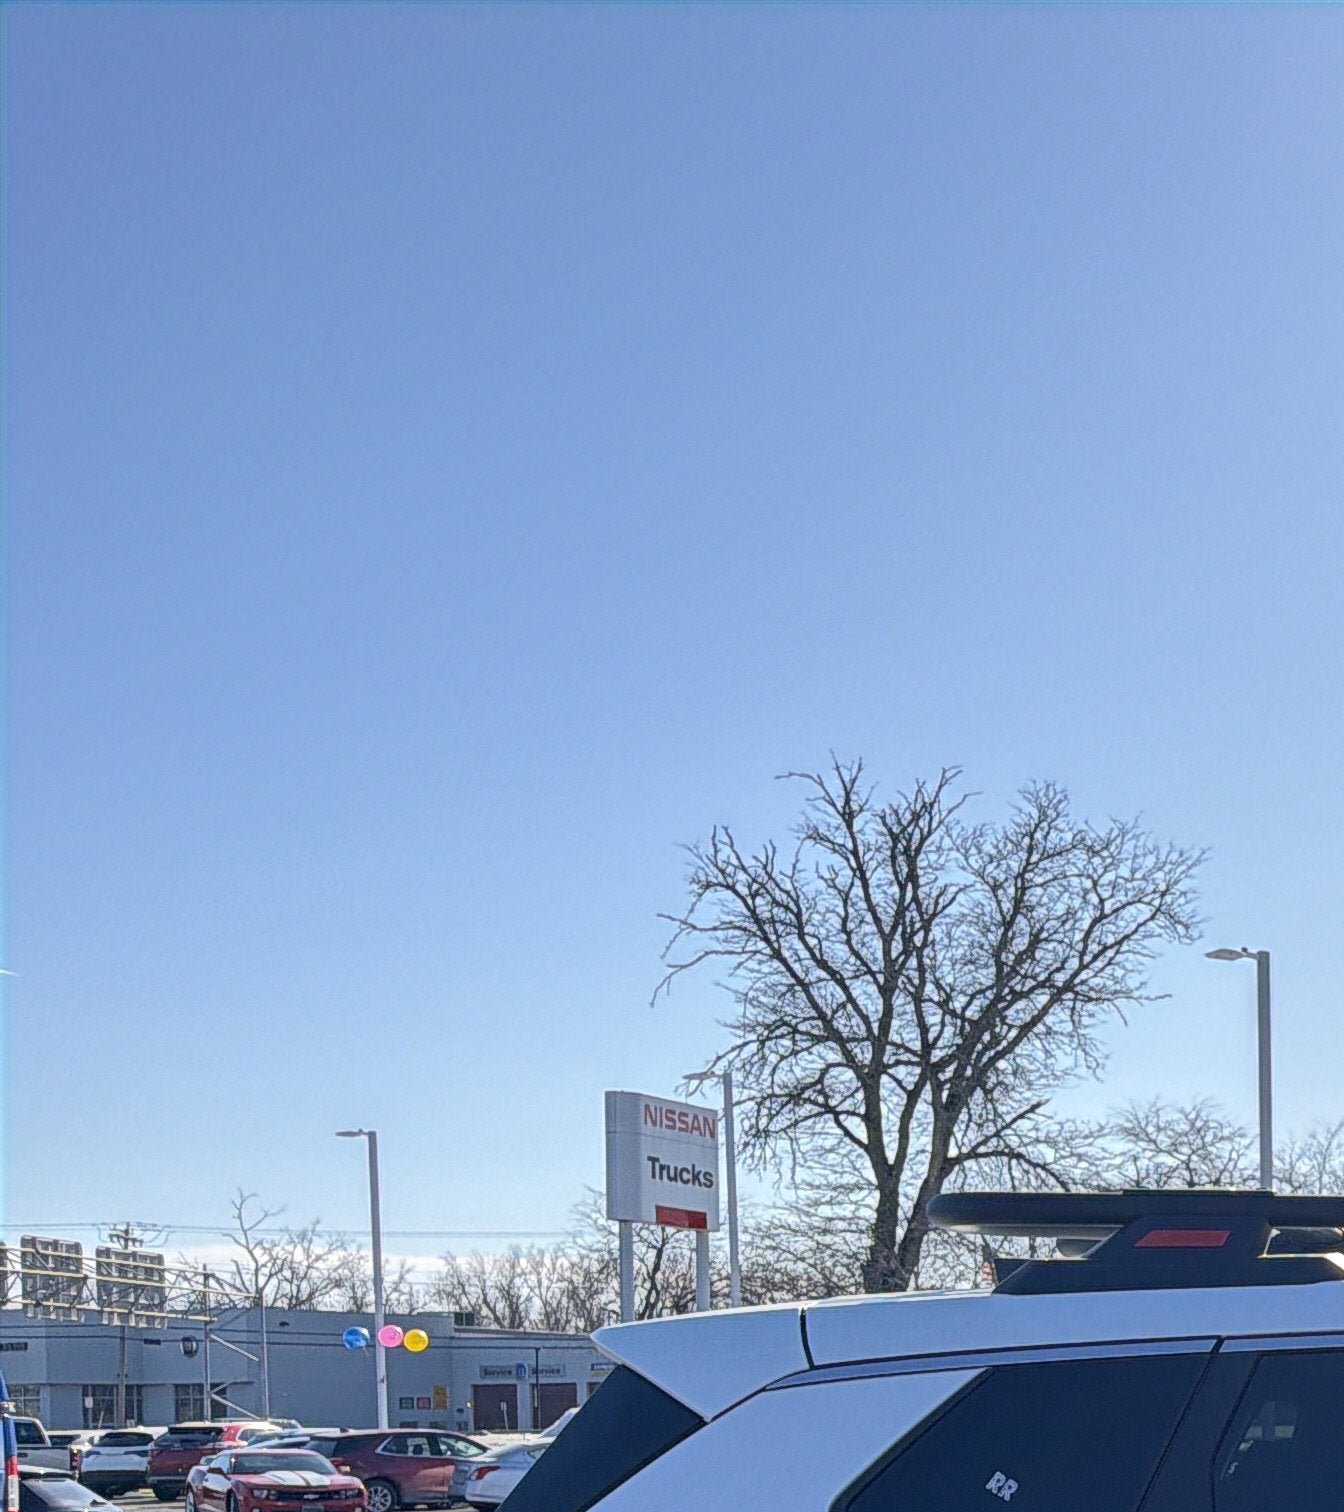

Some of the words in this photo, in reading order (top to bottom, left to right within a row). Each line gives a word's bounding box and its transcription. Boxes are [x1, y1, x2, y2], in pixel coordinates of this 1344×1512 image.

[644, 1103, 716, 1139] NISSAN
[646, 1155, 714, 1189] Trucks
[483, 1367, 512, 1376] Service
